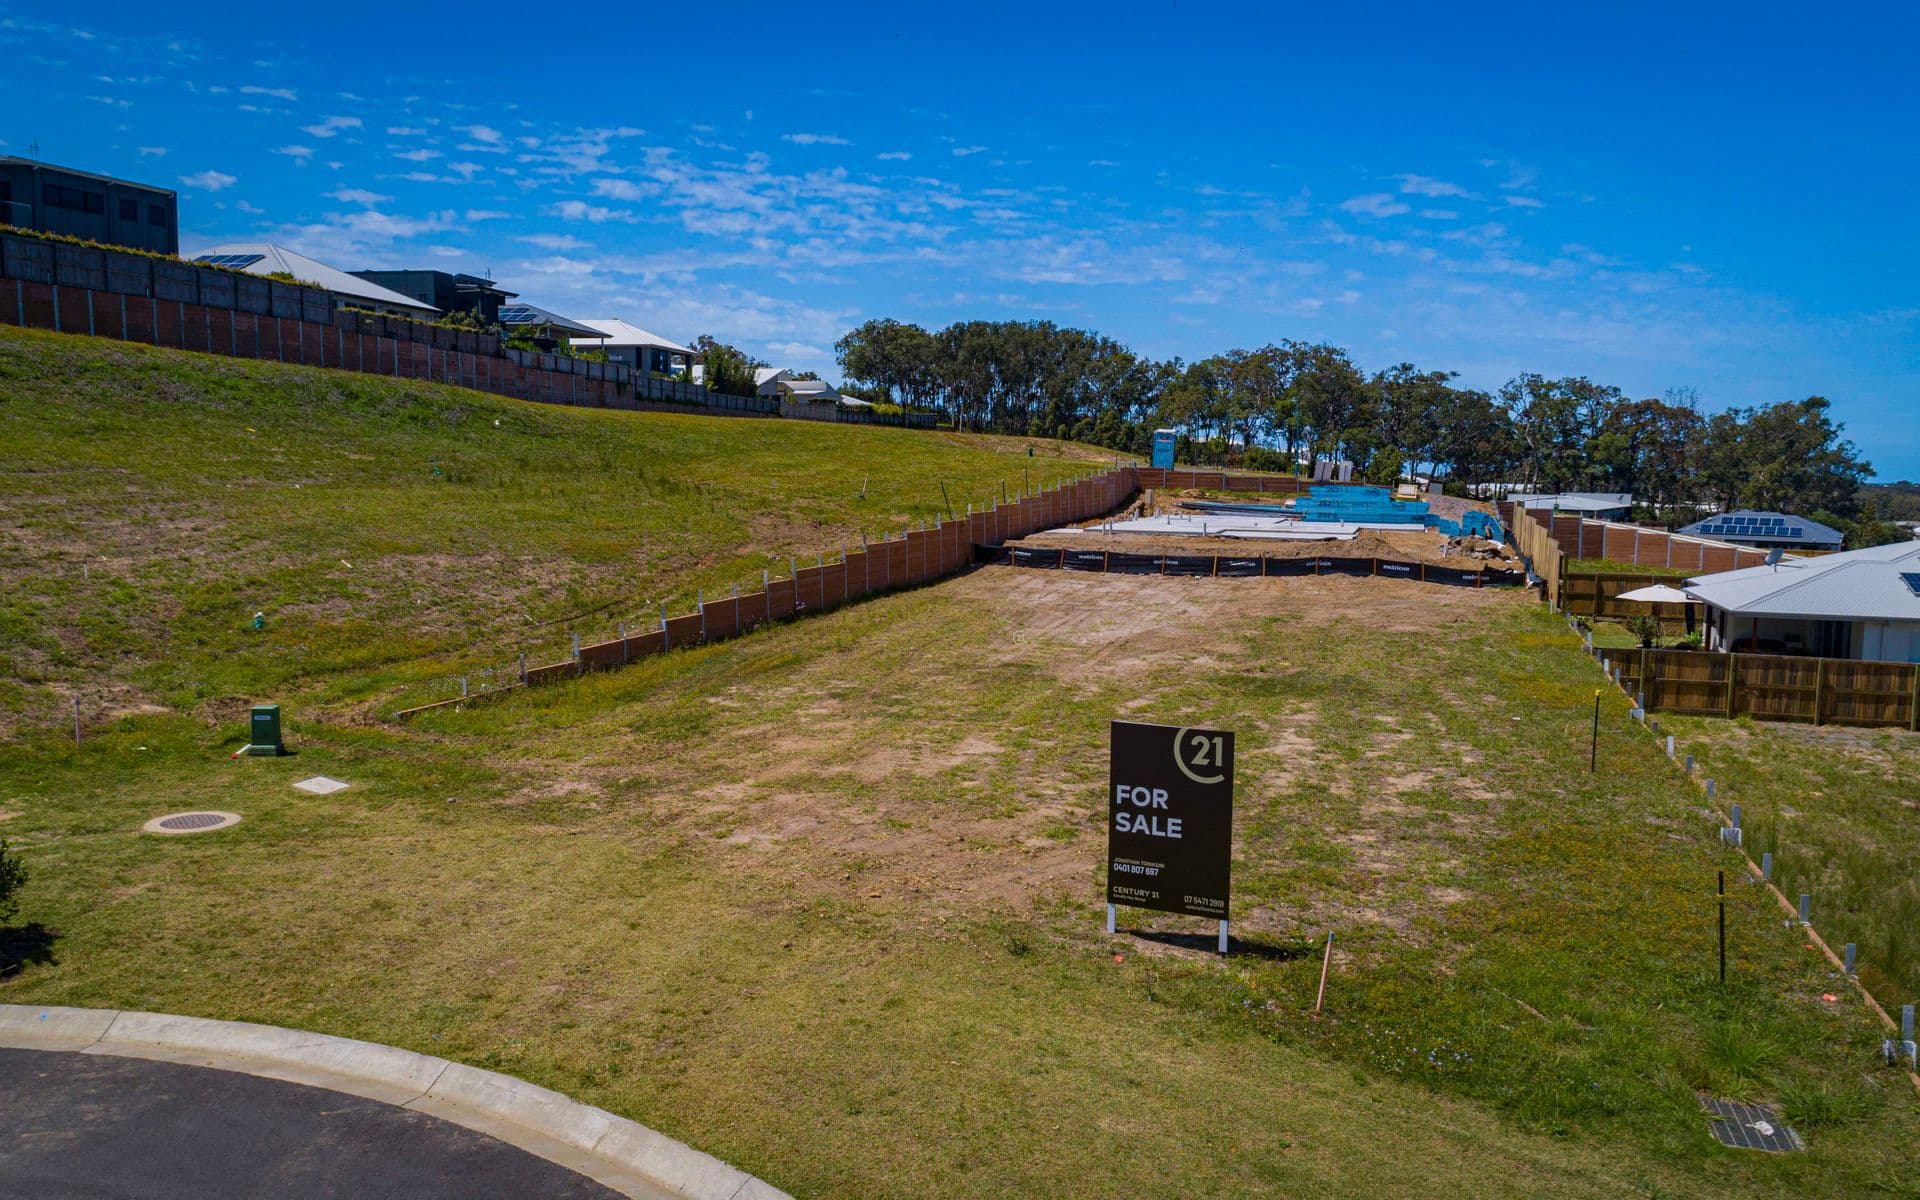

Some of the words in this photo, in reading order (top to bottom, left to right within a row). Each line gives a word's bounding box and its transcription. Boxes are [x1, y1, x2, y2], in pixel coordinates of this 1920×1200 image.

[1190, 735, 1224, 767] 21
[1116, 784, 1169, 810] FOR
[1115, 812, 1183, 839] SALE
[1113, 862, 1130, 873] 0401
[1131, 865, 1145, 874] 807
[1113, 886, 1151, 897] CENTURY
[1151, 891, 1160, 899] 21
[1184, 895, 1193, 903] 07
